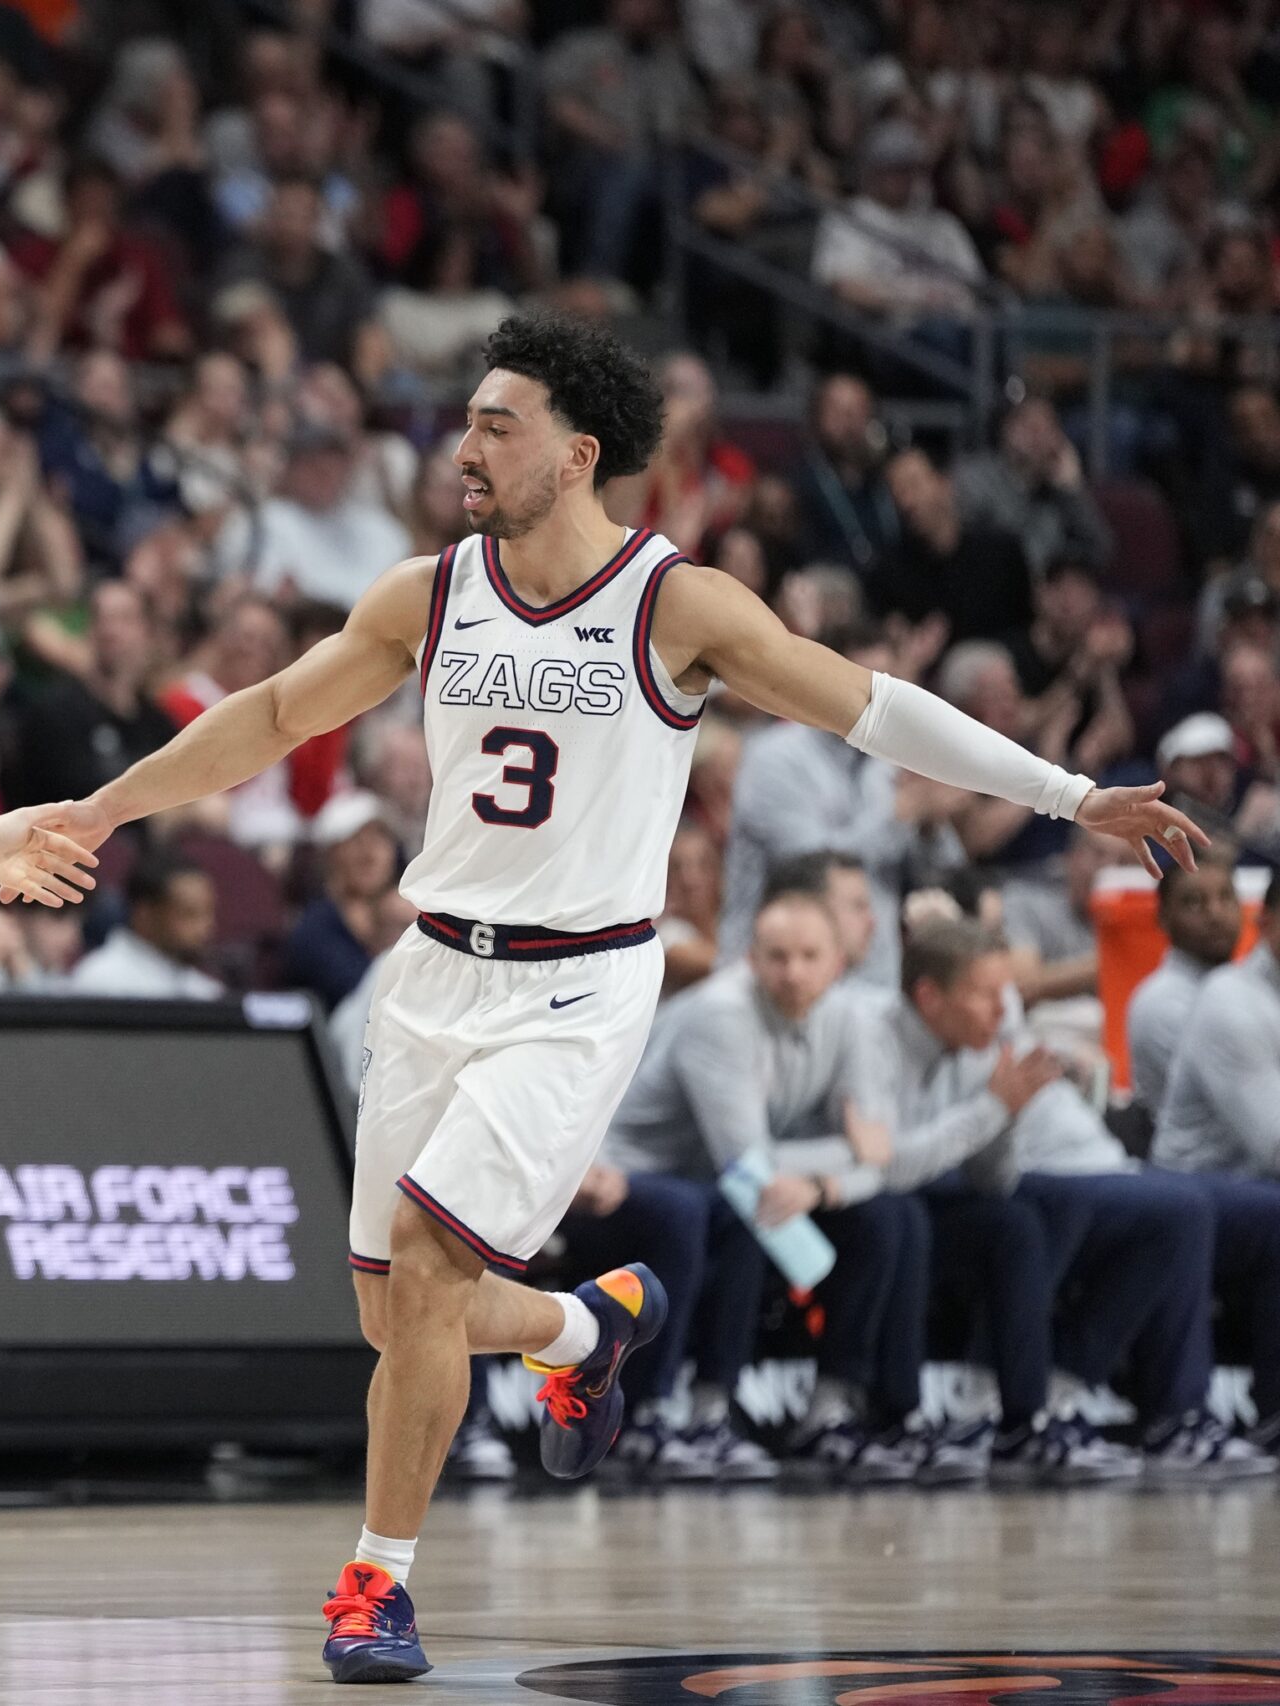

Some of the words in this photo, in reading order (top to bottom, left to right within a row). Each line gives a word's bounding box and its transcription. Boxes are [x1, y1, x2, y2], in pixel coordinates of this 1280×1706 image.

[573, 626, 615, 643] WCC
[439, 651, 625, 716] ZAGS
[472, 726, 559, 830] 3
[470, 923, 495, 957] G
[91, 1165, 298, 1224] FORCE
[5, 1223, 296, 1281] RESERVE
